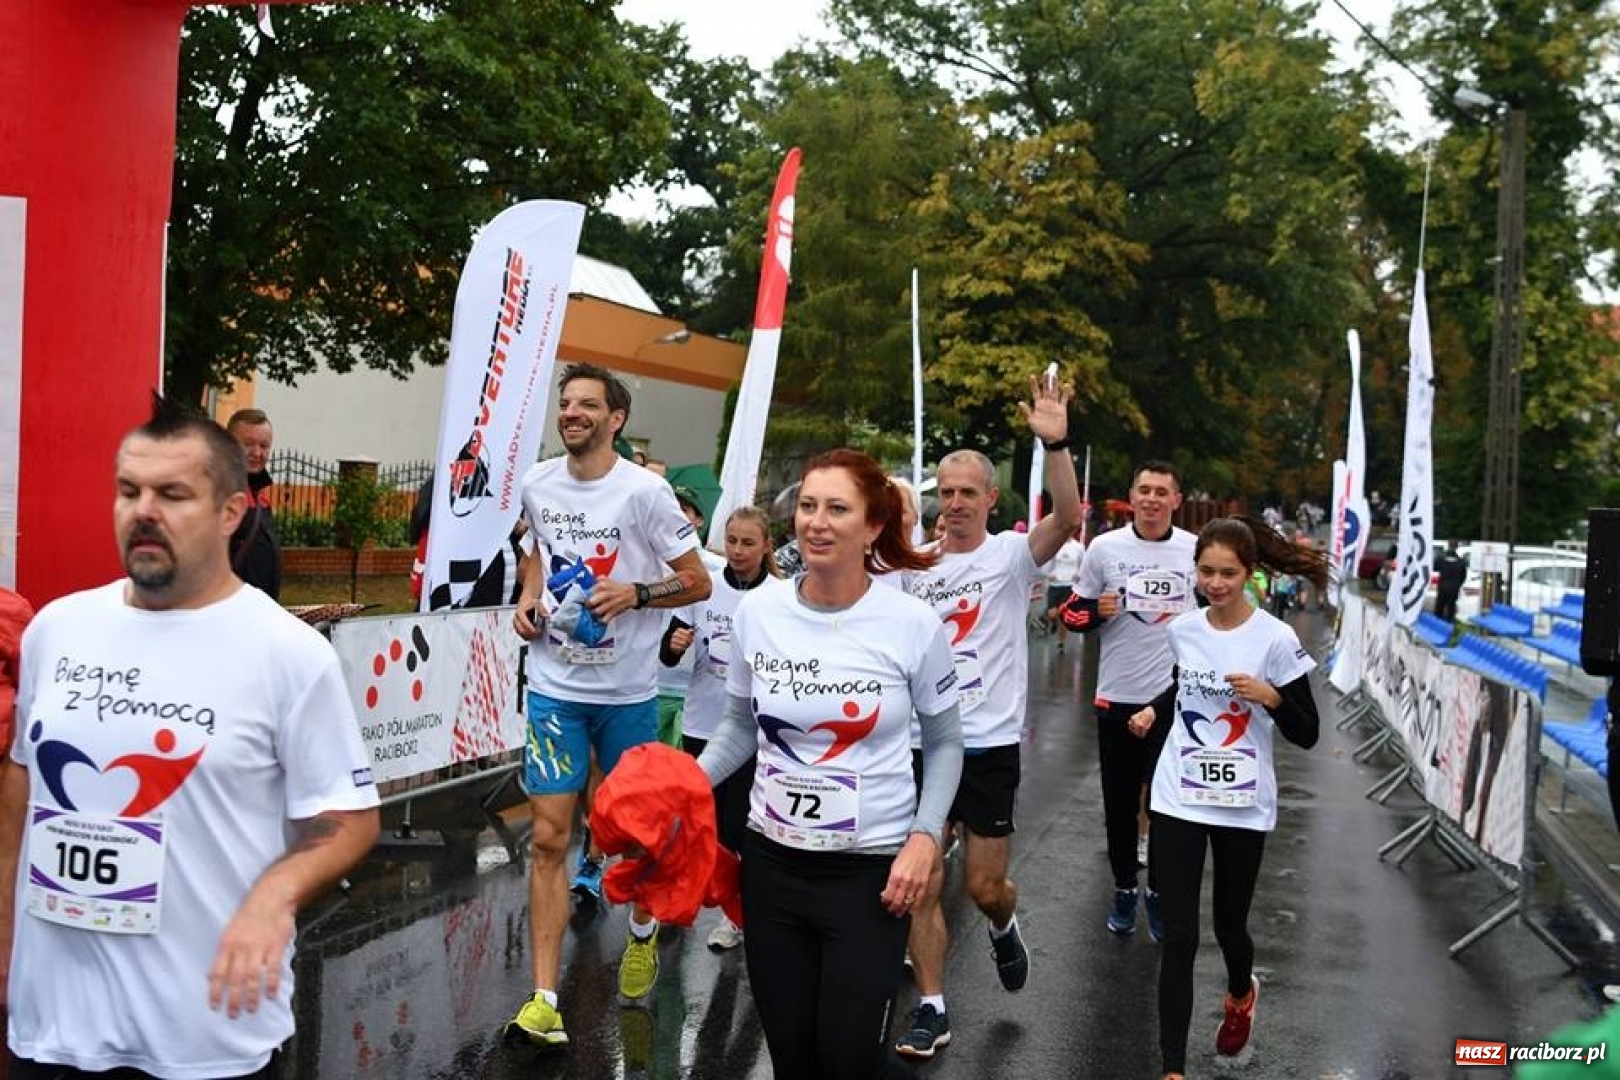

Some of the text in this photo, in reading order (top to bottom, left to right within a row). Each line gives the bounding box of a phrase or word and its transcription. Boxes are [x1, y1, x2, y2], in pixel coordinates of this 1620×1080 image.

[1143, 580, 1172, 595] 129
[54, 656, 141, 701] Biegnę
[753, 651, 821, 687] Biegnę
[791, 679, 883, 702] pomocą
[97, 694, 215, 735] pomocą
[1199, 762, 1236, 784] 156
[786, 790, 822, 820] 72
[55, 841, 119, 886] 106
